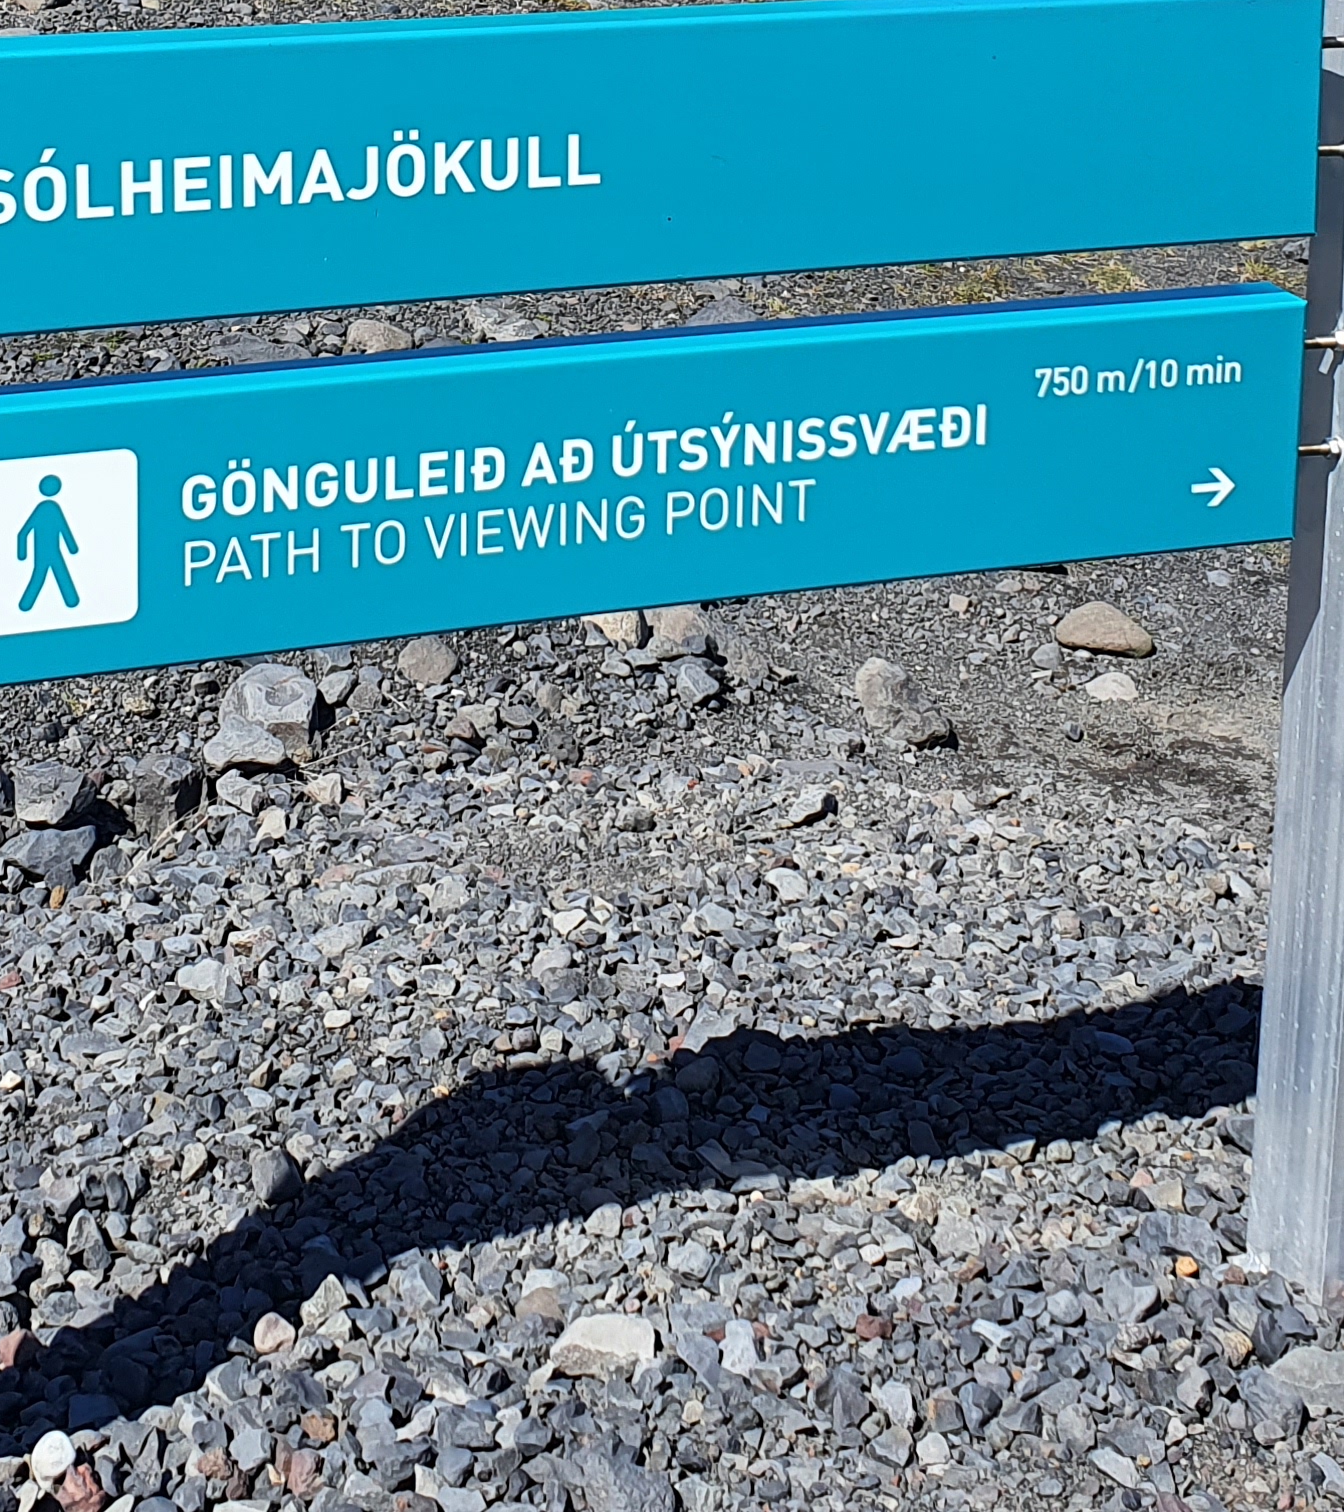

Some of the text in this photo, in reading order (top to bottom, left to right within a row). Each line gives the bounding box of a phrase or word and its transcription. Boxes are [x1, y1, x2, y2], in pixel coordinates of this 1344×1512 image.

[1034, 354, 1243, 399] 750 m/10 min
[181, 403, 988, 521] GÖNGULEIÐ AÐ ÚTSÝNISSVÆÐI
[183, 478, 817, 588] PATH TO VIEWING POINT
